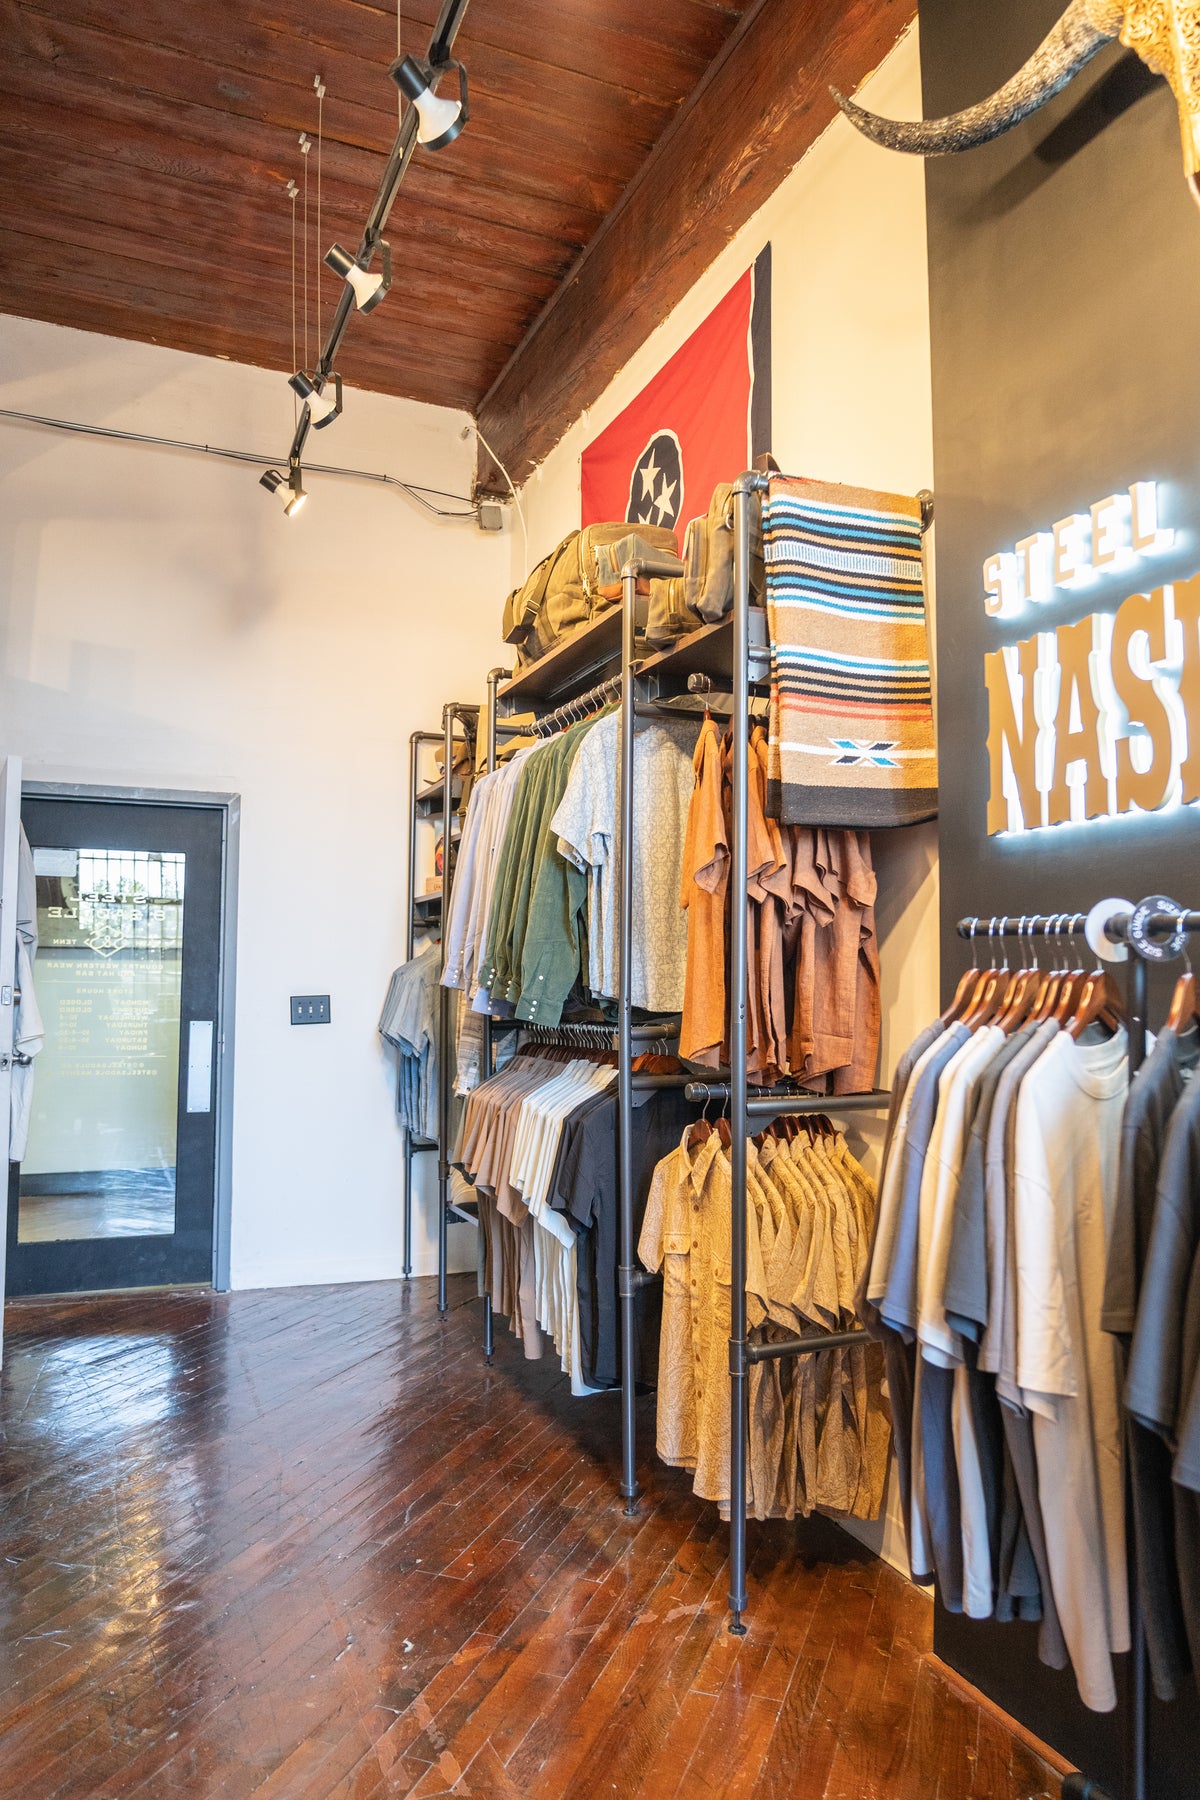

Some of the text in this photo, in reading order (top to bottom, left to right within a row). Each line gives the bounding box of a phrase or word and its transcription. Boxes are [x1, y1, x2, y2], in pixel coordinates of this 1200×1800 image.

[982, 480, 1174, 617] STEEL
[1132, 905, 1163, 958] SIZE GUIDE
